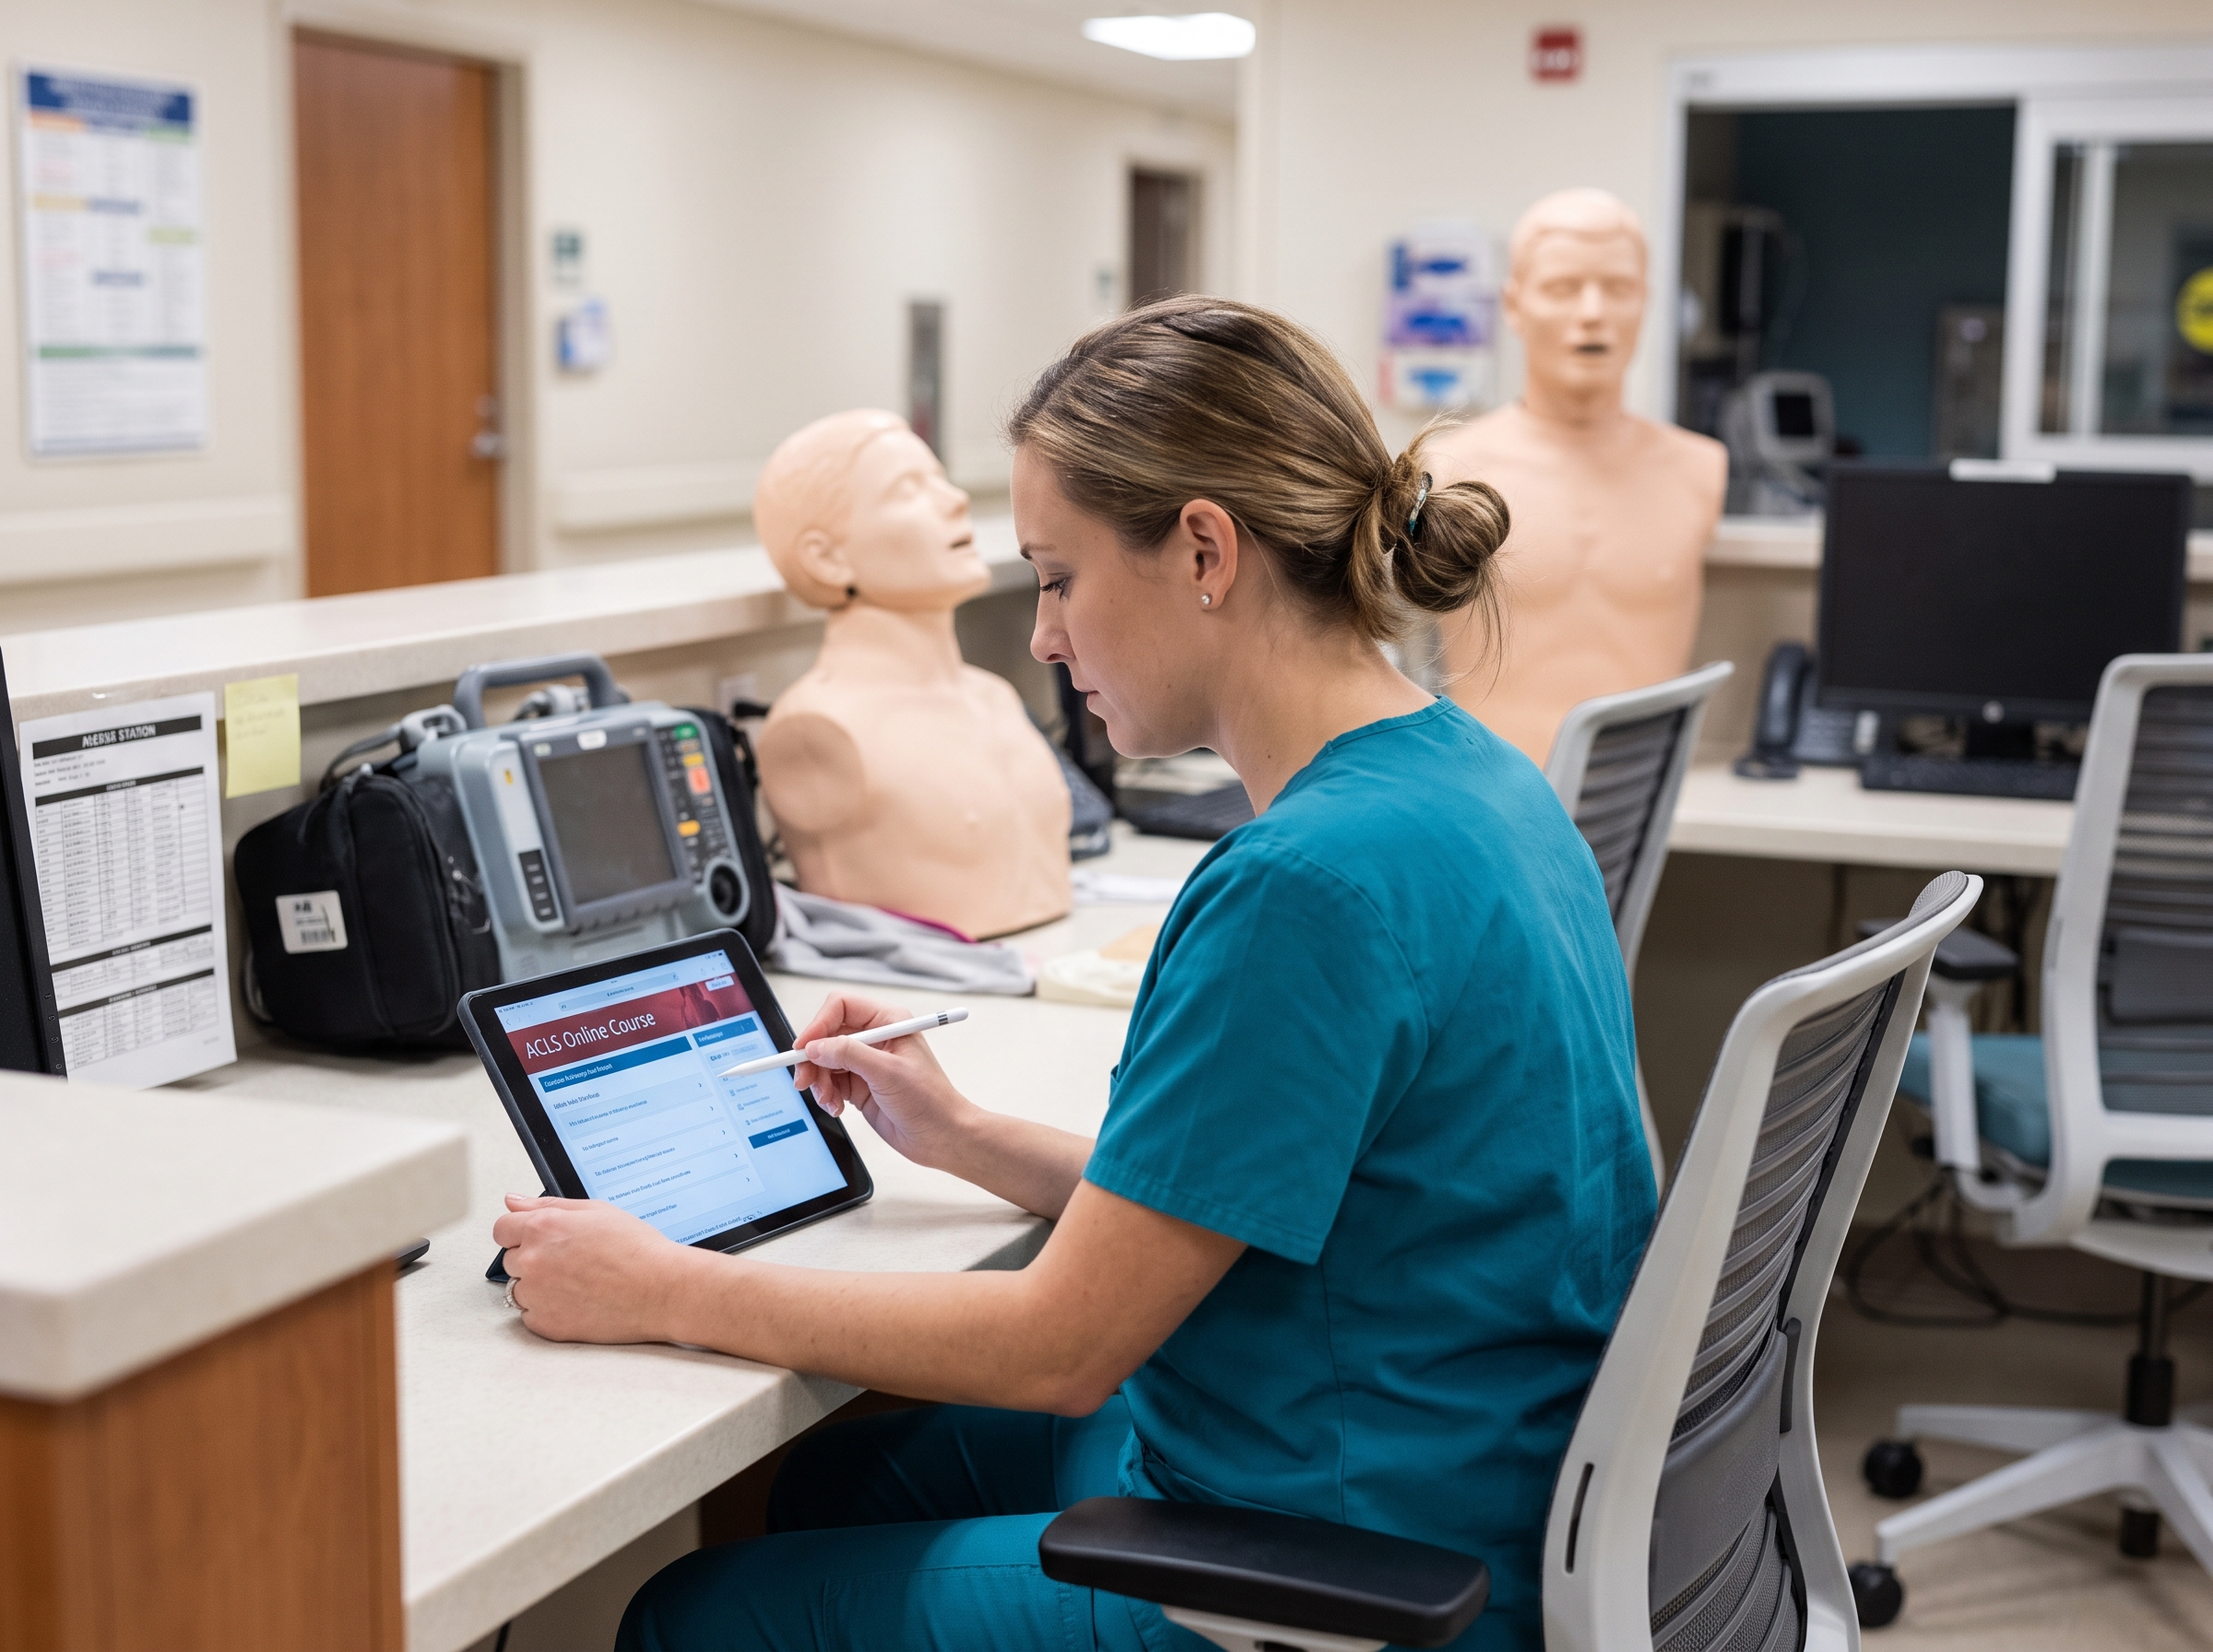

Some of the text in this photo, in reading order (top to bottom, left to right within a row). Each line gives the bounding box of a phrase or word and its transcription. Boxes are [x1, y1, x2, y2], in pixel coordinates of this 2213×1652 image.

[118, 724, 156, 742] STATION
[526, 1013, 657, 1059] ACLS Online Course
